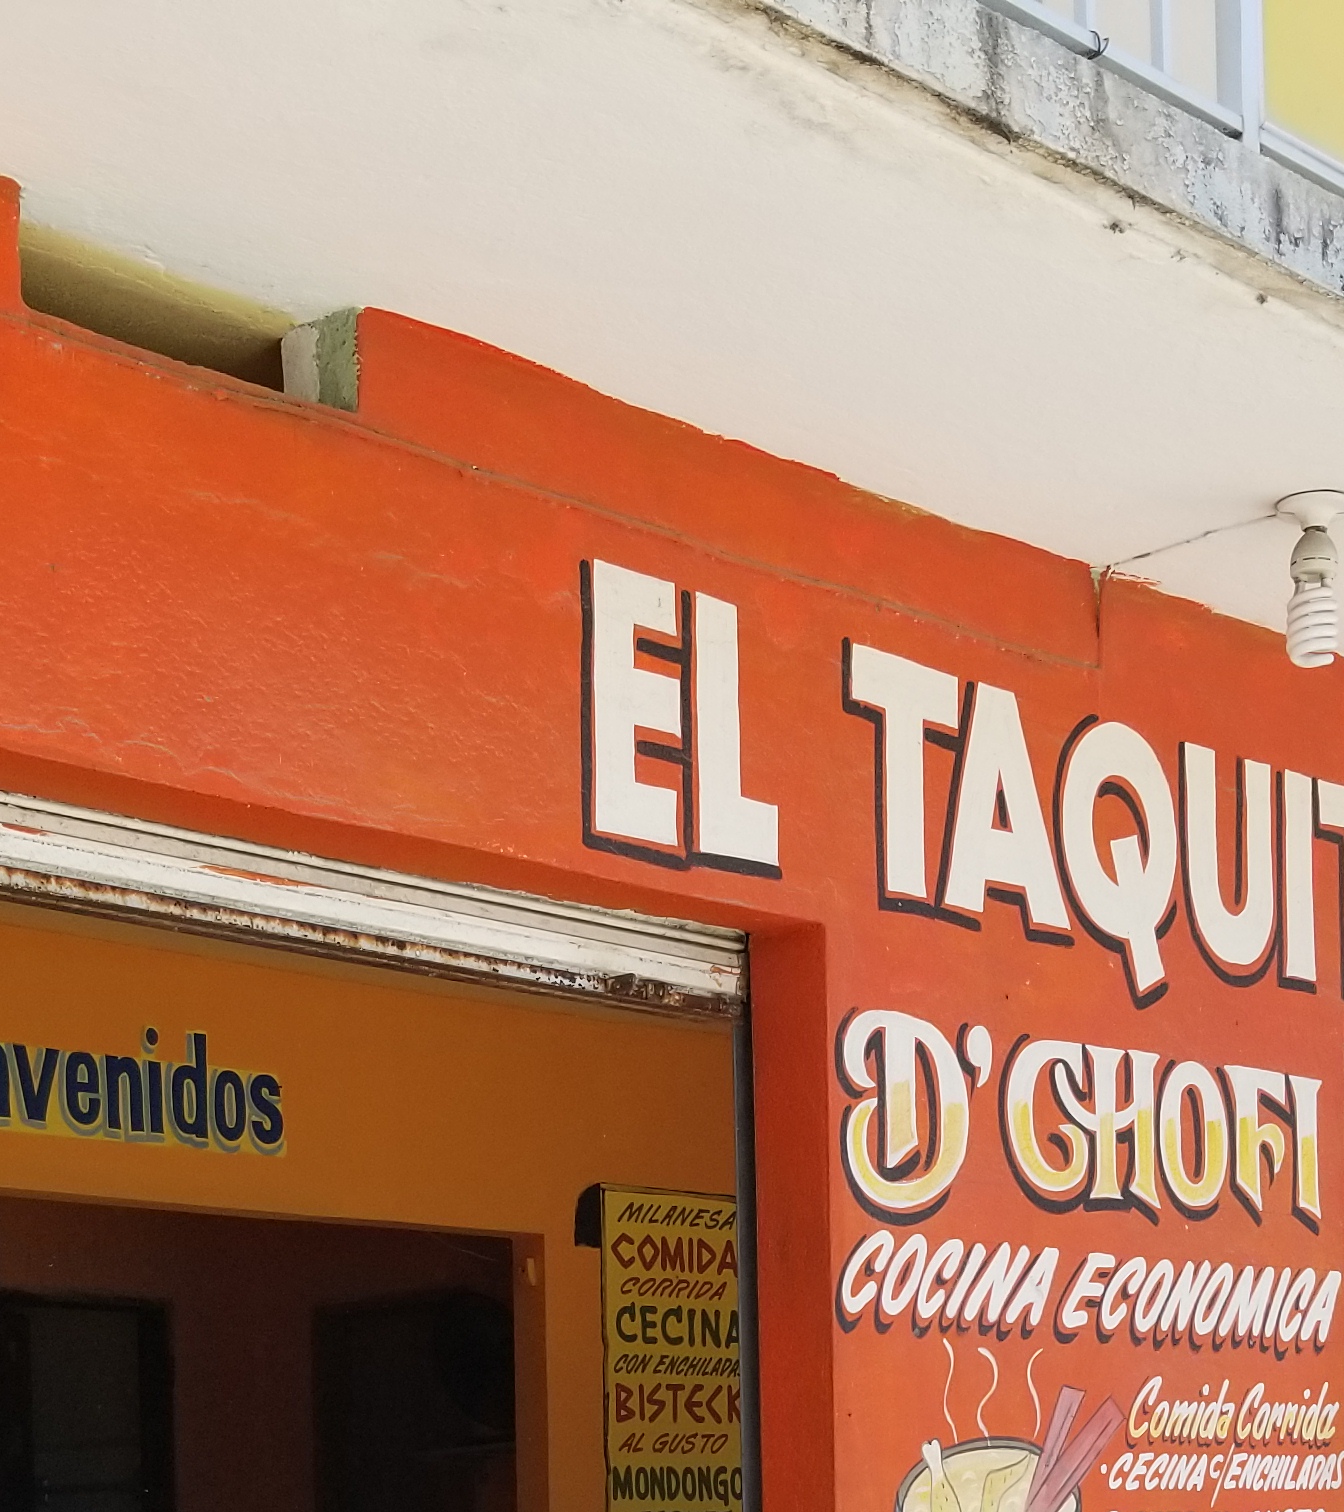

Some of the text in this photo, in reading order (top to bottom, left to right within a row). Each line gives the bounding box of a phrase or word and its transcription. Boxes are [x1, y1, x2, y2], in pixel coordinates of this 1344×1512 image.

[580, 557, 781, 879] EL
[617, 1203, 736, 1231] MILANESA
[611, 1232, 737, 1278] COMIDA
[620, 1277, 727, 1300] CORRIDA
[836, 1229, 1342, 1358] COCINA ECONOMICA
[615, 1302, 739, 1349] CECINA
[614, 1354, 648, 1374] CON
[1127, 1376, 1339, 1448] Comida Corrida
[619, 1432, 728, 1455] AL GUSTO
[612, 1465, 743, 1507] MONDONGO
[1108, 1451, 1217, 1491] CECINA
